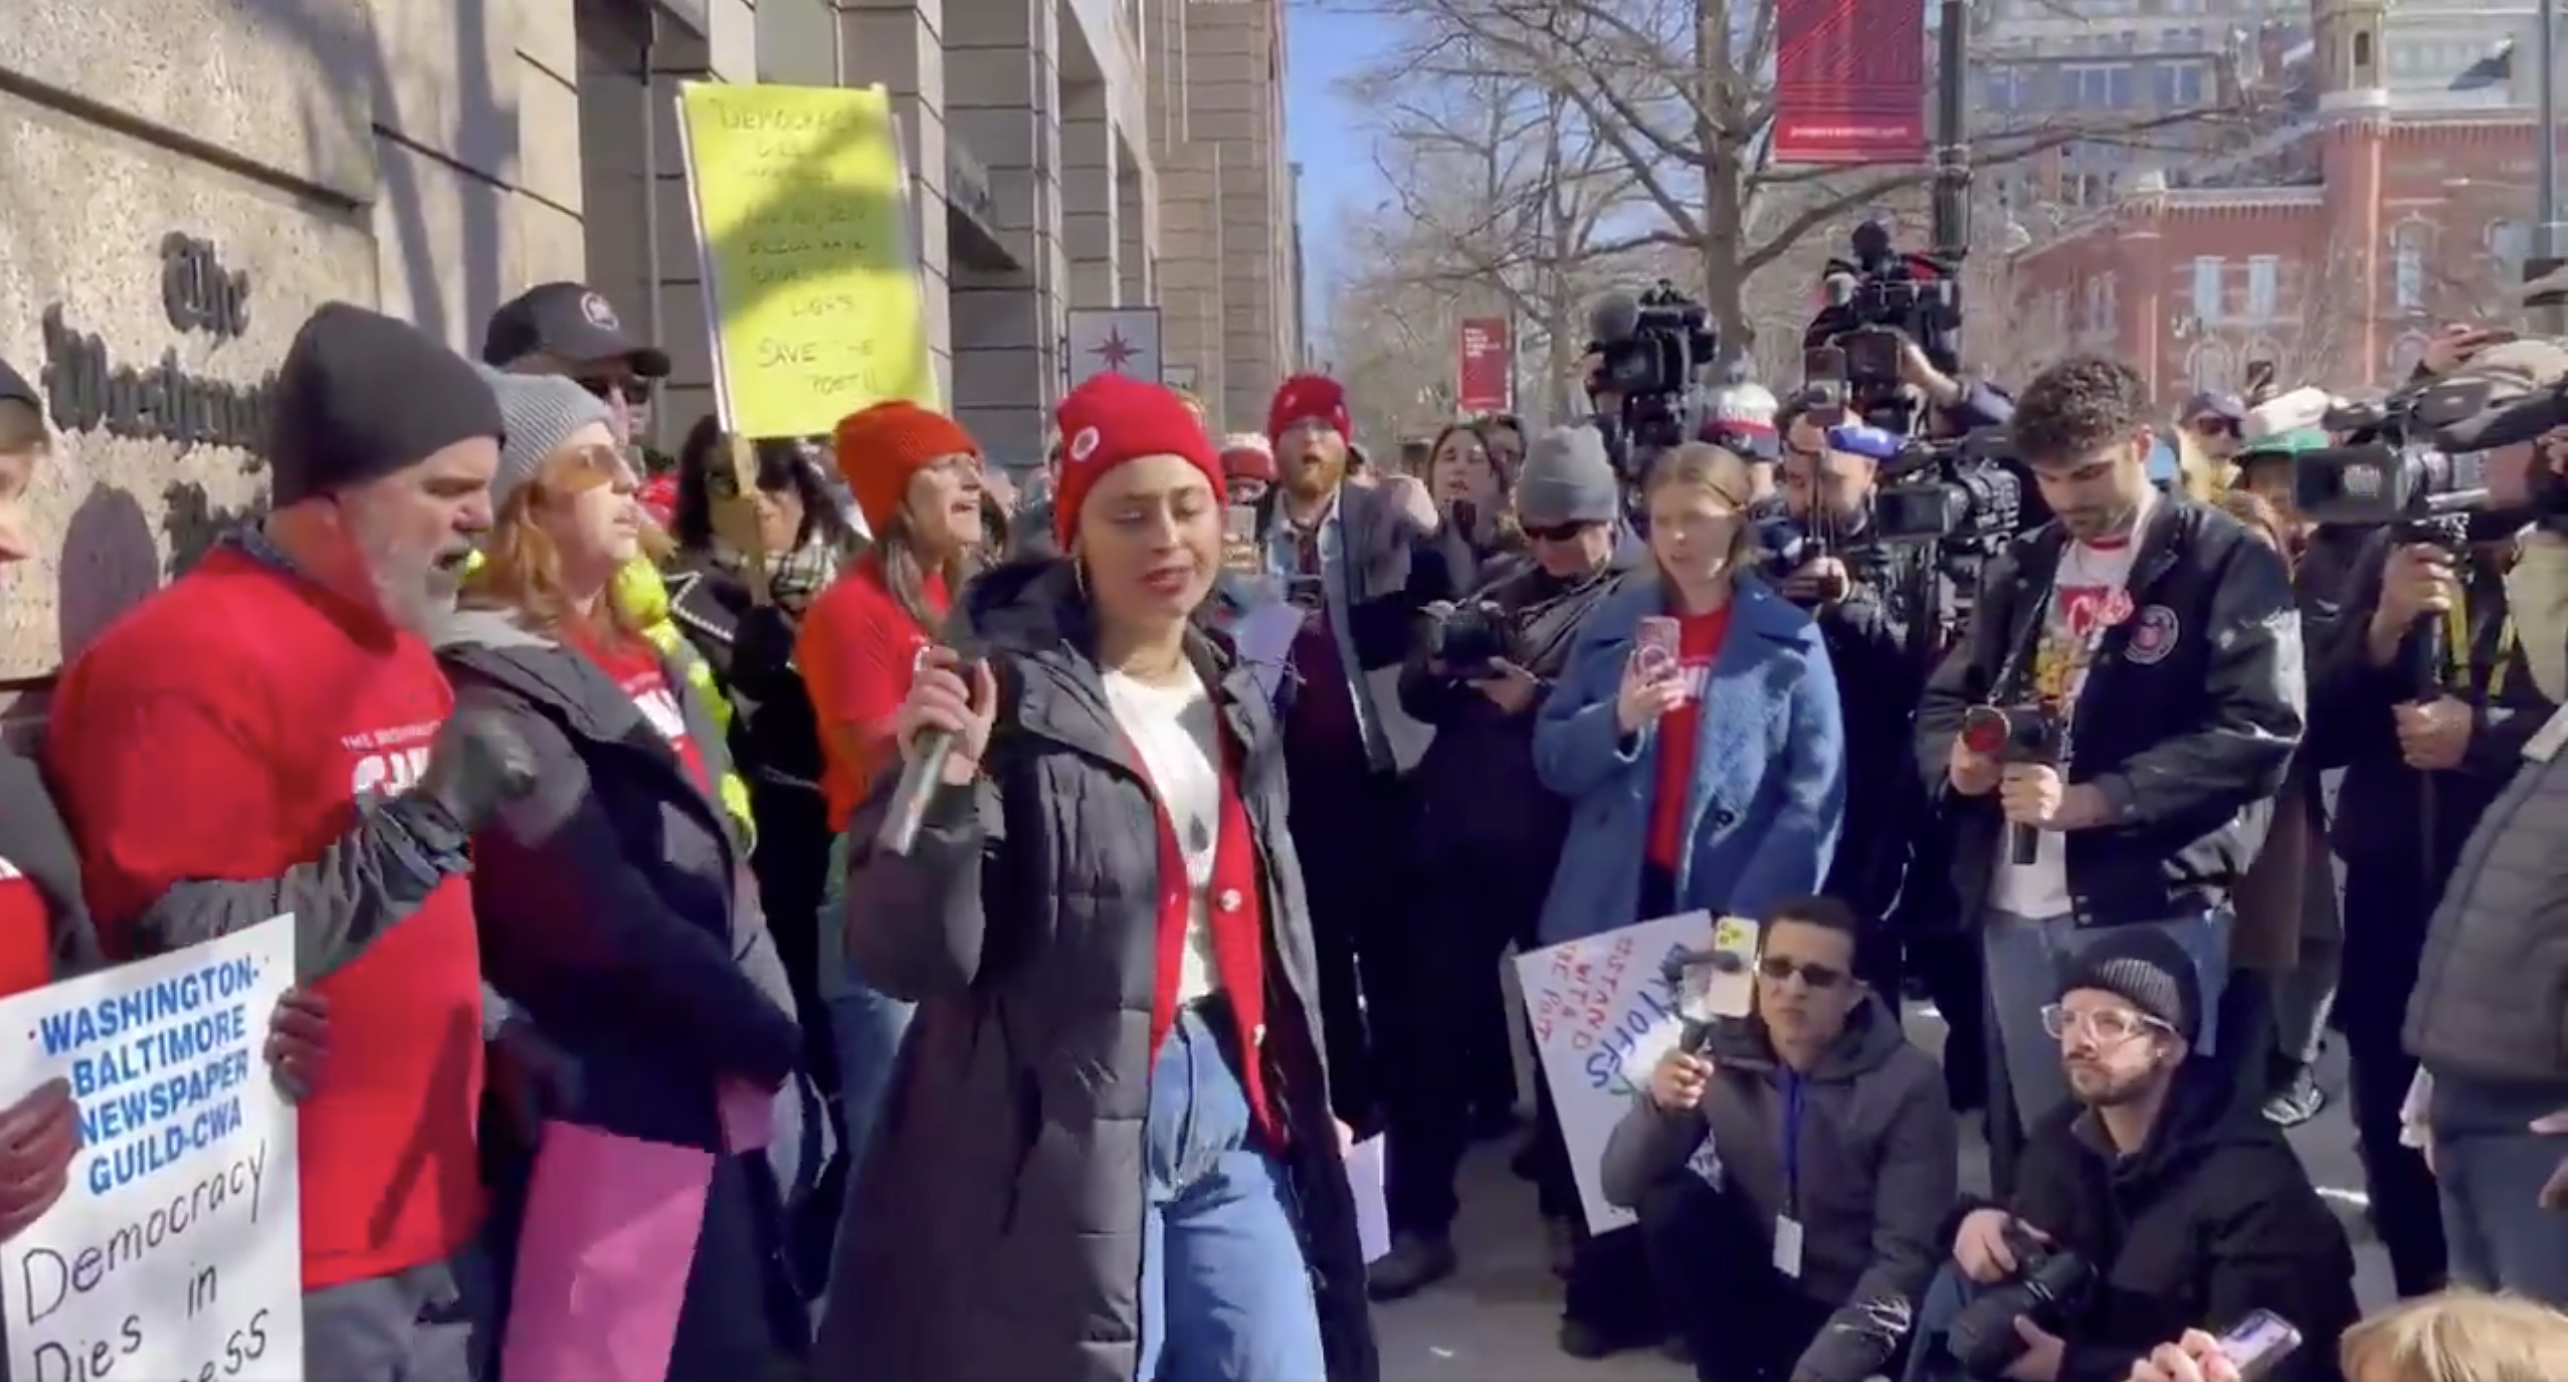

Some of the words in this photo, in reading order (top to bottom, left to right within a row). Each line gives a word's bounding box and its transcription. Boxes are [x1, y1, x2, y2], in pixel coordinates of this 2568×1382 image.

[757, 337, 818, 368] SAVE
[72, 1004, 247, 1098] BALTIMORE
[76, 1048, 249, 1148] NEWSPAPER
[89, 1099, 242, 1196] GUILD-CWA
[22, 1139, 267, 1326] Democracy
[34, 1314, 142, 1382] Dies
[187, 1259, 217, 1320] in
